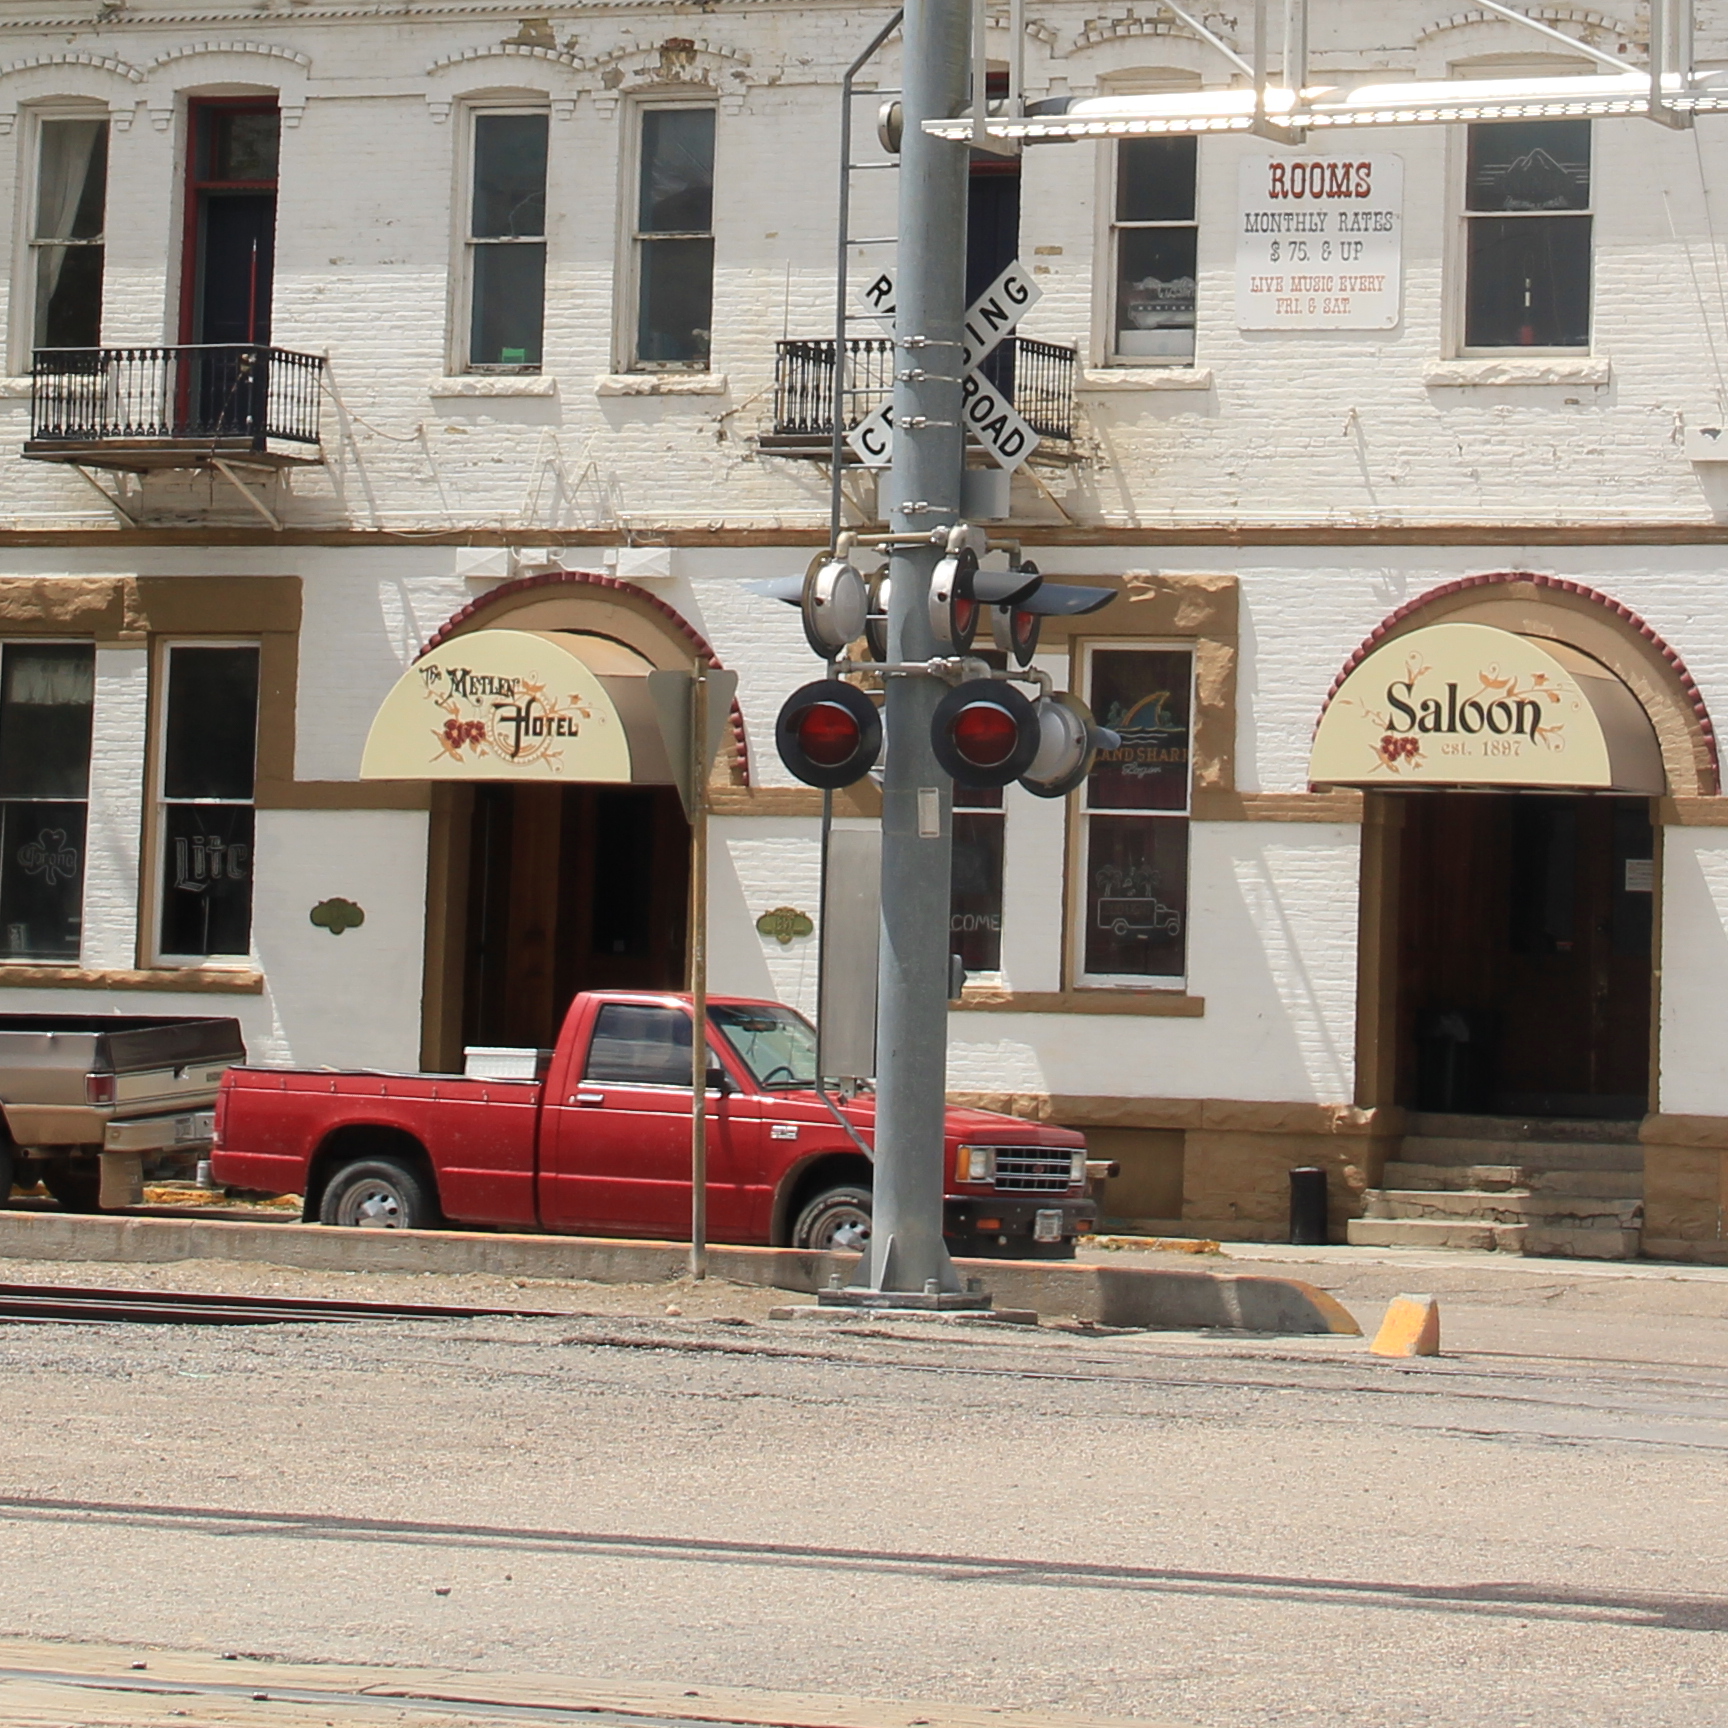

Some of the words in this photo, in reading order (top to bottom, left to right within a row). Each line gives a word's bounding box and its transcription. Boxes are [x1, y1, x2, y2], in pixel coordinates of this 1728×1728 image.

[1269, 161, 1373, 200] ROOMS
[1244, 212, 1329, 234] MONTHLY
[1338, 210, 1394, 233] RATES
[1270, 238, 1281, 264] $
[1288, 240, 1311, 262] 75.
[1321, 240, 1333, 261] &
[1340, 240, 1364, 261] UP
[1250, 276, 1284, 294] LIVE
[1289, 275, 1334, 293] MUSIC
[1338, 275, 1387, 293] EVERY
[1275, 298, 1303, 315] FRI.
[1307, 298, 1317, 314] &
[1323, 298, 1352, 315] SAT.
[1385, 682, 1542, 746] Saloon
[492, 696, 578, 759] HOTEL
[1441, 742, 1472, 757] est.
[1481, 741, 1522, 757] 1897
[174, 835, 248, 892] Lite
